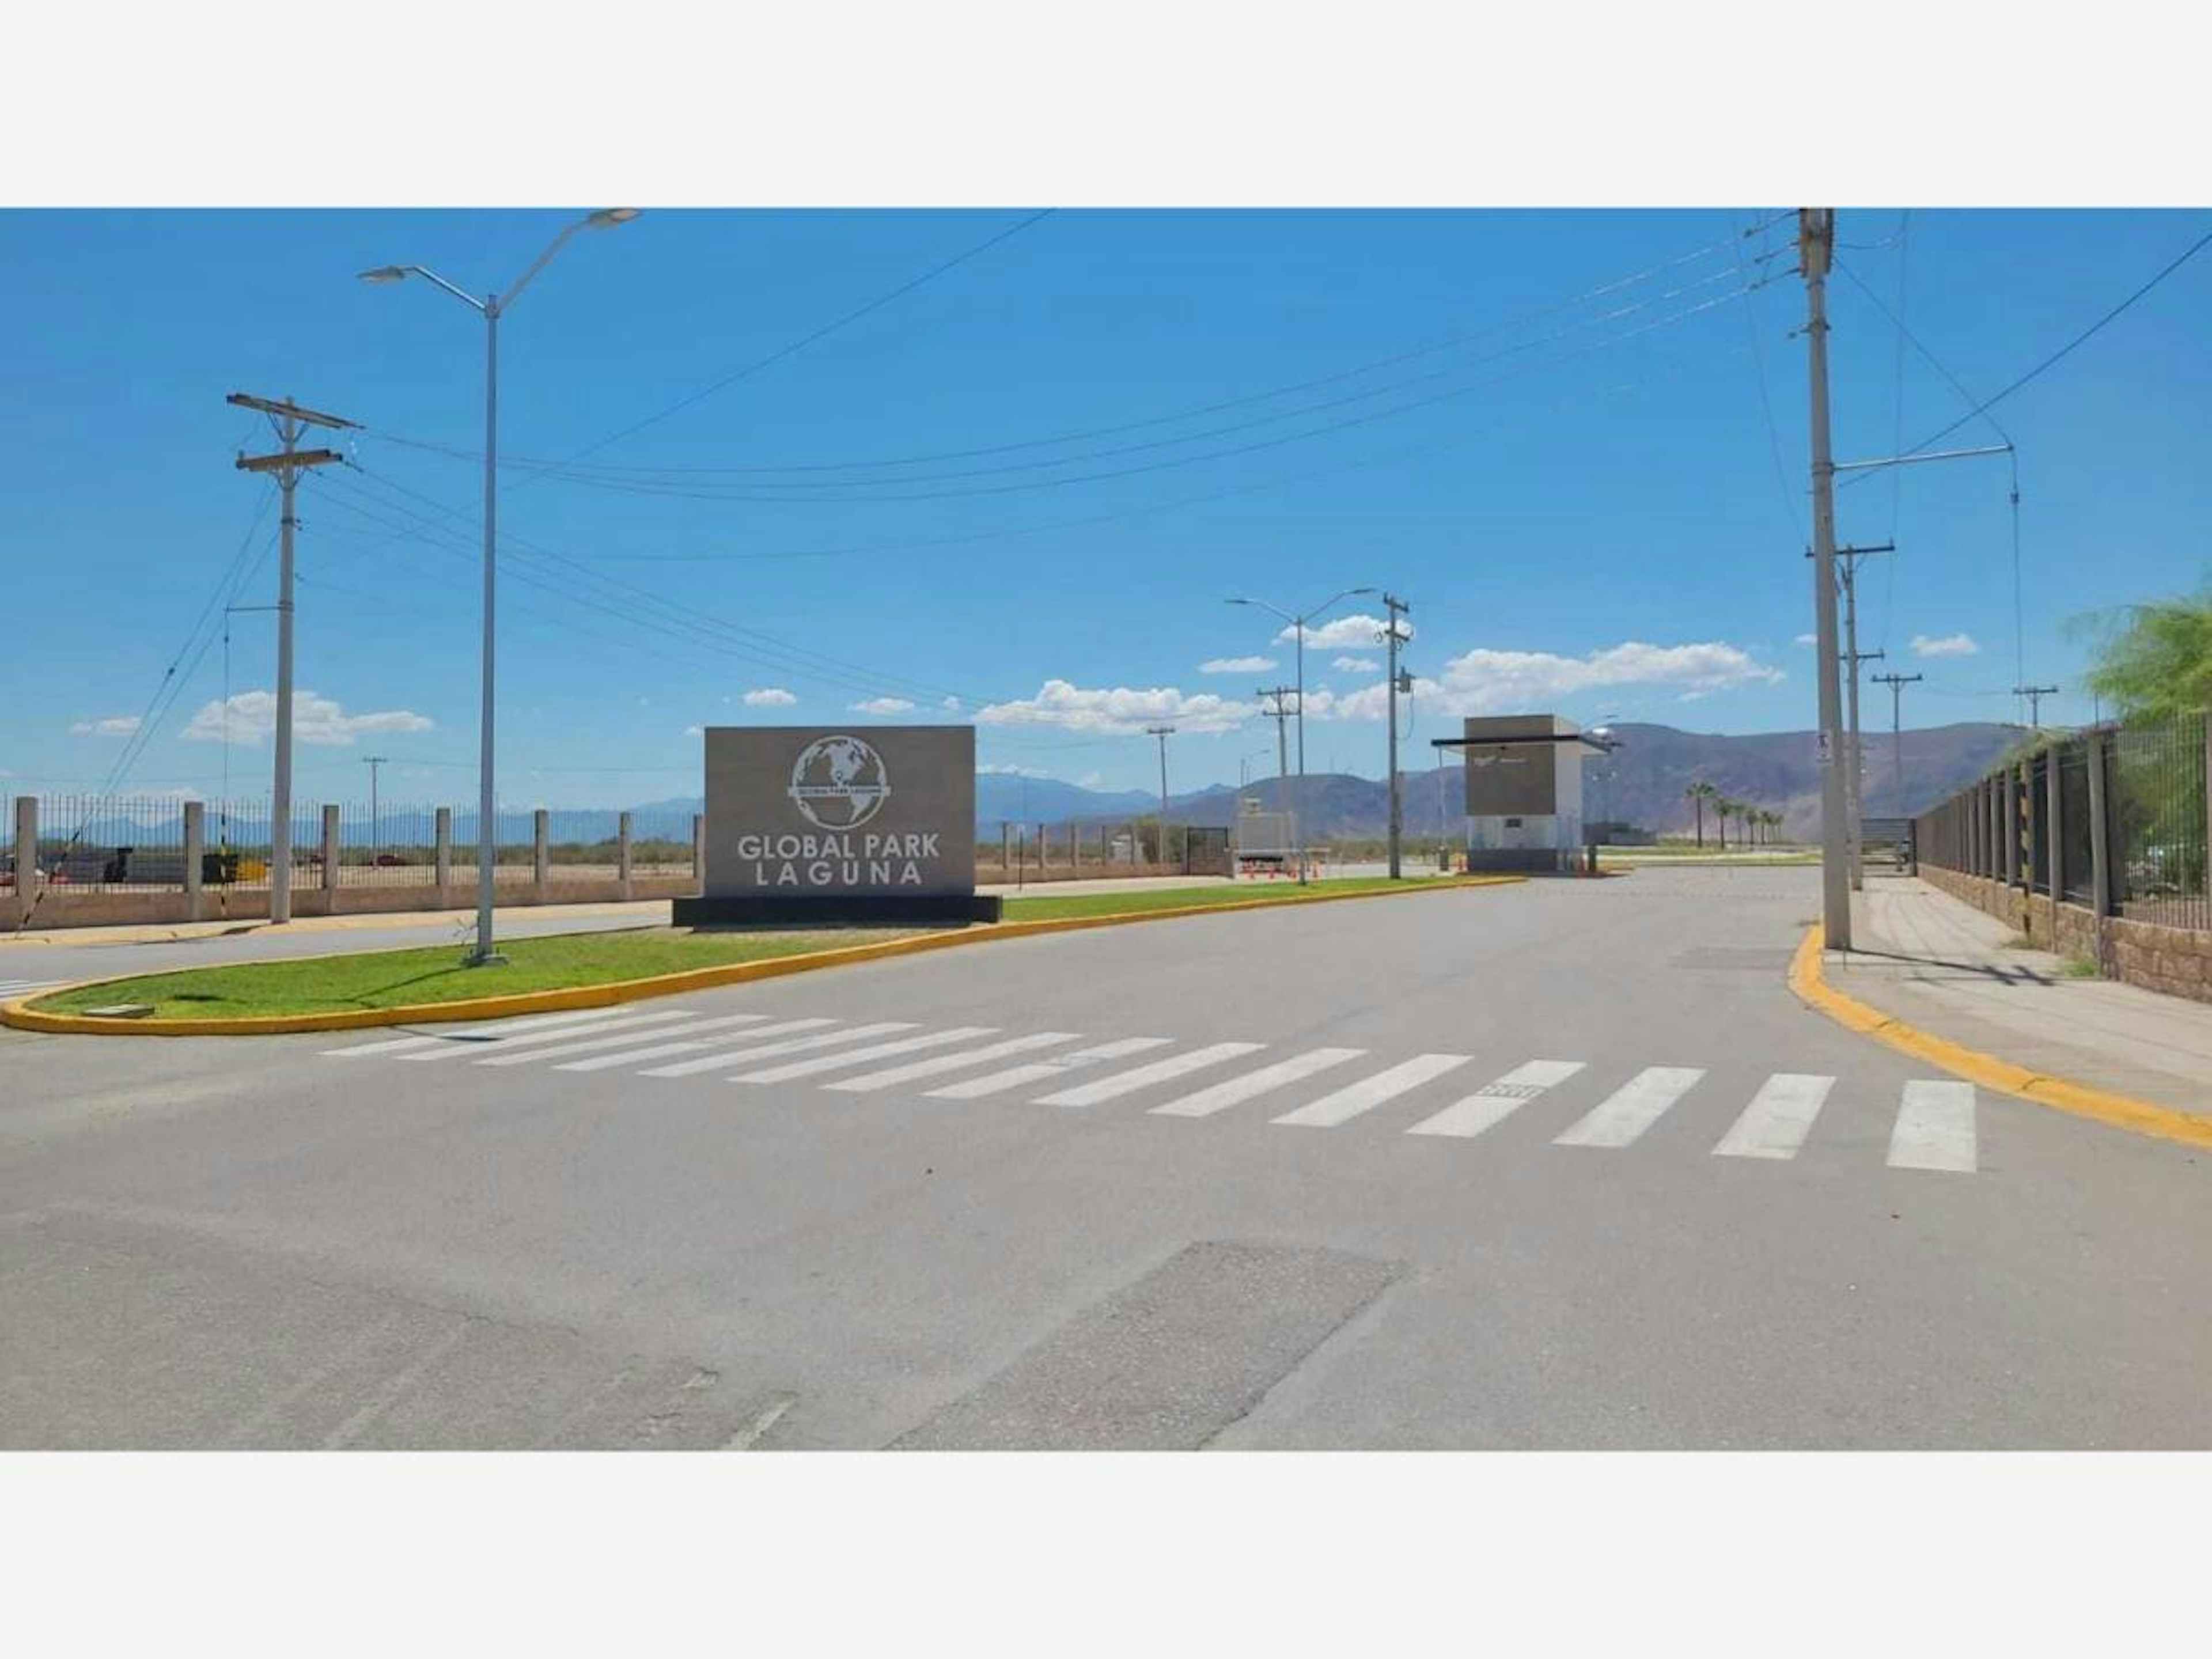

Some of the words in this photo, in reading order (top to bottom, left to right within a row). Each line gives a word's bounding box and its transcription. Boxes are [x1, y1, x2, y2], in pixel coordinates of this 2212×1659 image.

[738, 835, 855, 859] GLOBAL
[865, 834, 940, 858] PARK
[756, 861, 922, 885] LAGUNA
